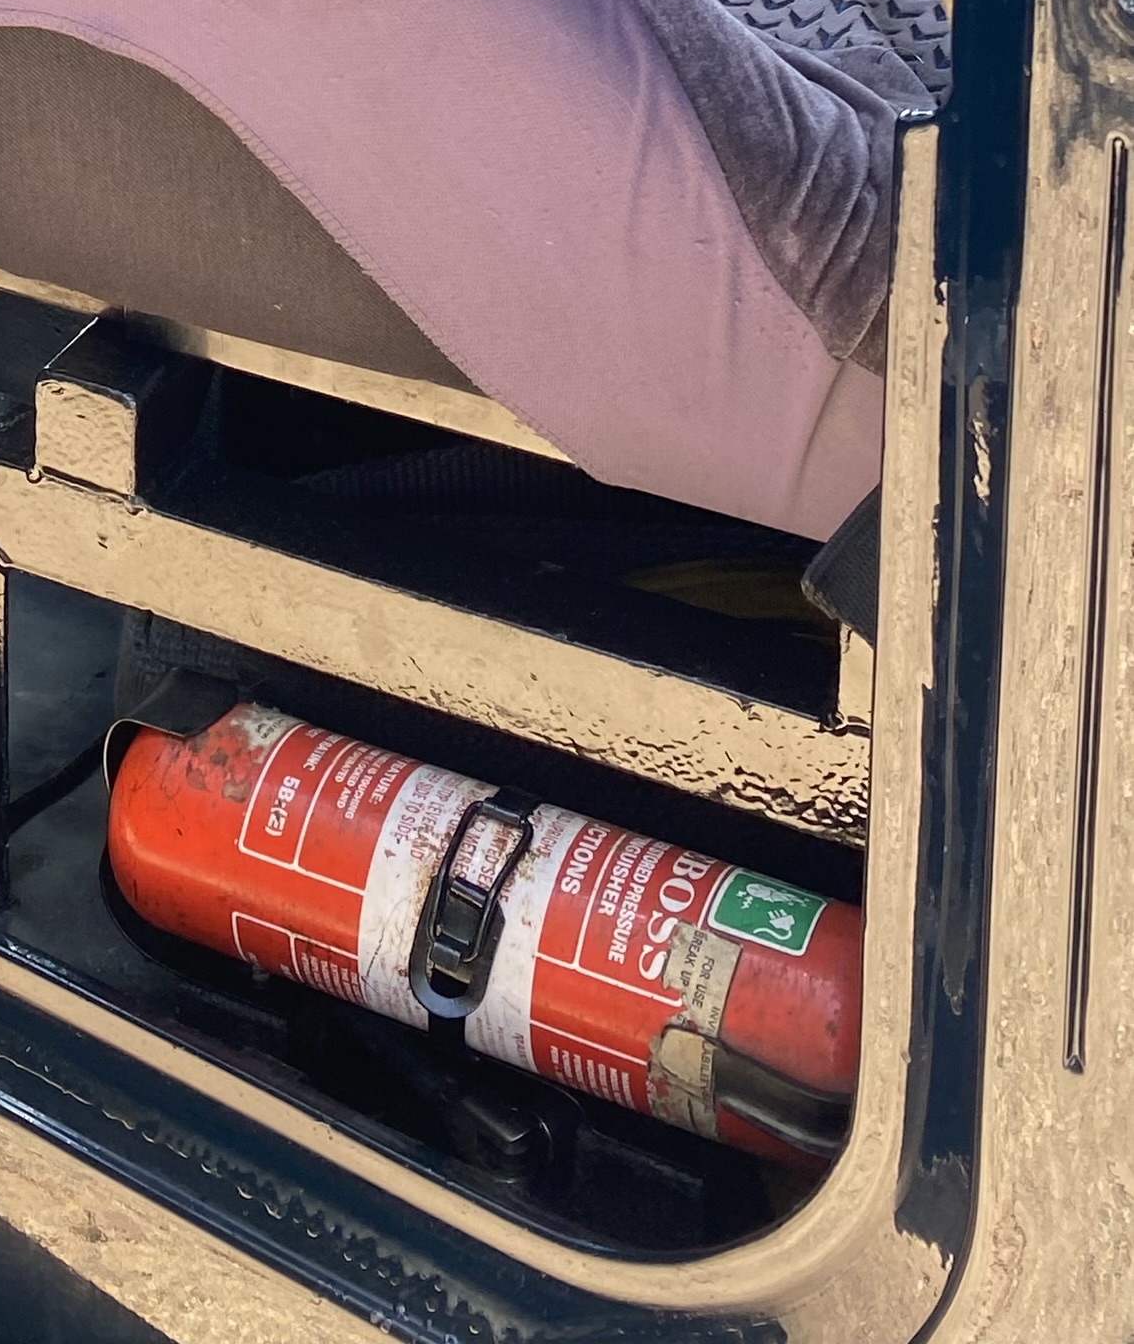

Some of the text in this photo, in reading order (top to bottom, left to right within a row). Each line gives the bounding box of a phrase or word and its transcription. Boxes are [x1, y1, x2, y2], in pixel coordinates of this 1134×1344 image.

[335, 750, 362, 782] OPERATED
[345, 759, 366, 787] LOCKED
[369, 760, 406, 805] FEATURE:
[337, 787, 351, 808] AND
[345, 774, 372, 819] TOUCHING
[404, 799, 424, 815] TO
[452, 832, 479, 879] METRES
[631, 846, 664, 885] STORED
[608, 881, 644, 964] PRESSURE
[677, 929, 705, 987] BREAK UP
[691, 955, 715, 1008] FOR USE
